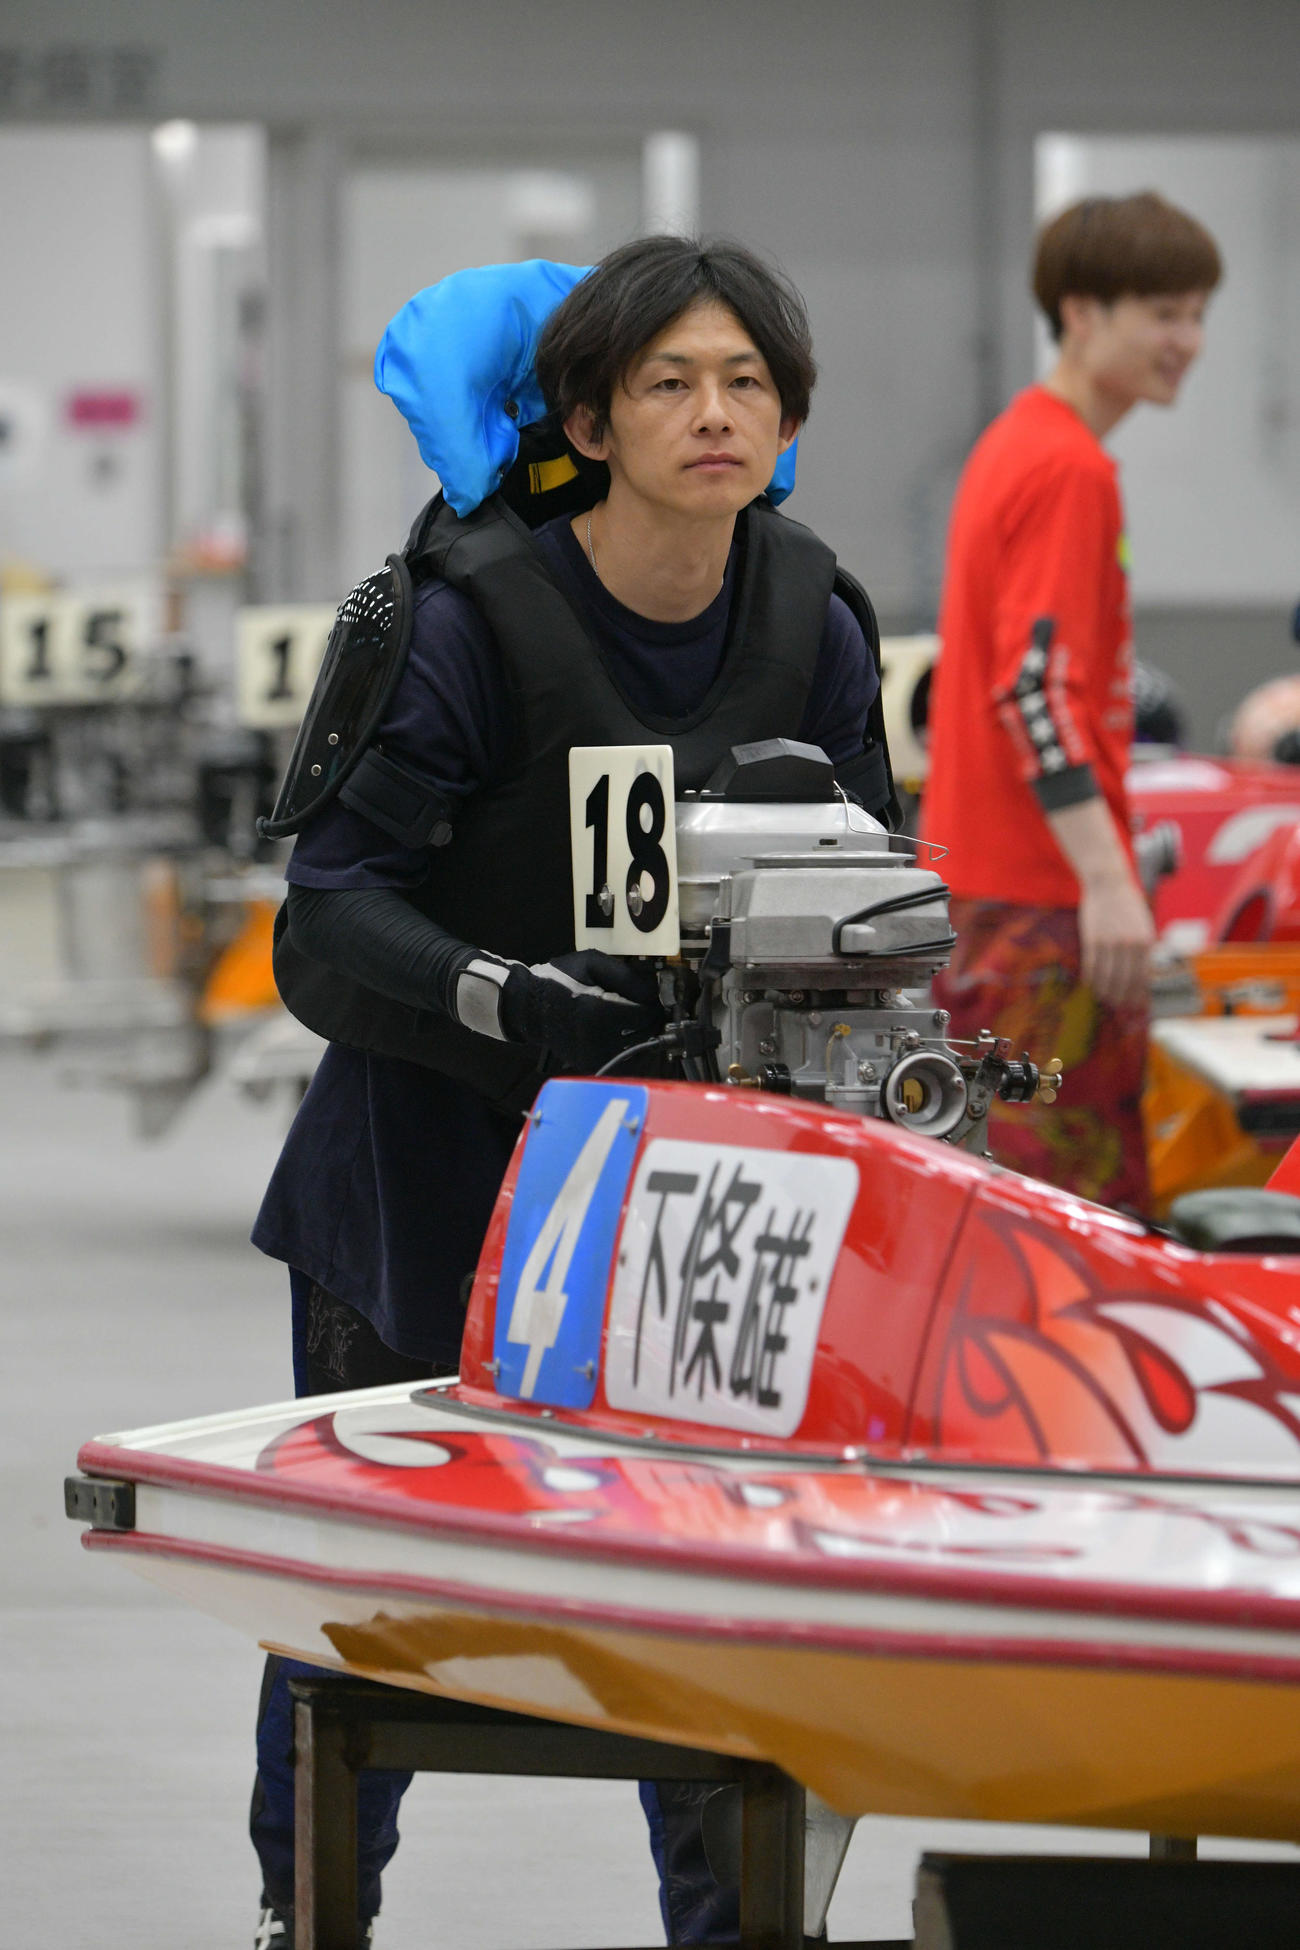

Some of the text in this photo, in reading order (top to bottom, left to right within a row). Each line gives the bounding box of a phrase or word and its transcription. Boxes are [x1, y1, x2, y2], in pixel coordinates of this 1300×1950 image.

[27, 609, 127, 682] 15
[585, 771, 670, 933] 18
[507, 1099, 629, 1399] 4
[631, 1161, 816, 1408] 下條雄
